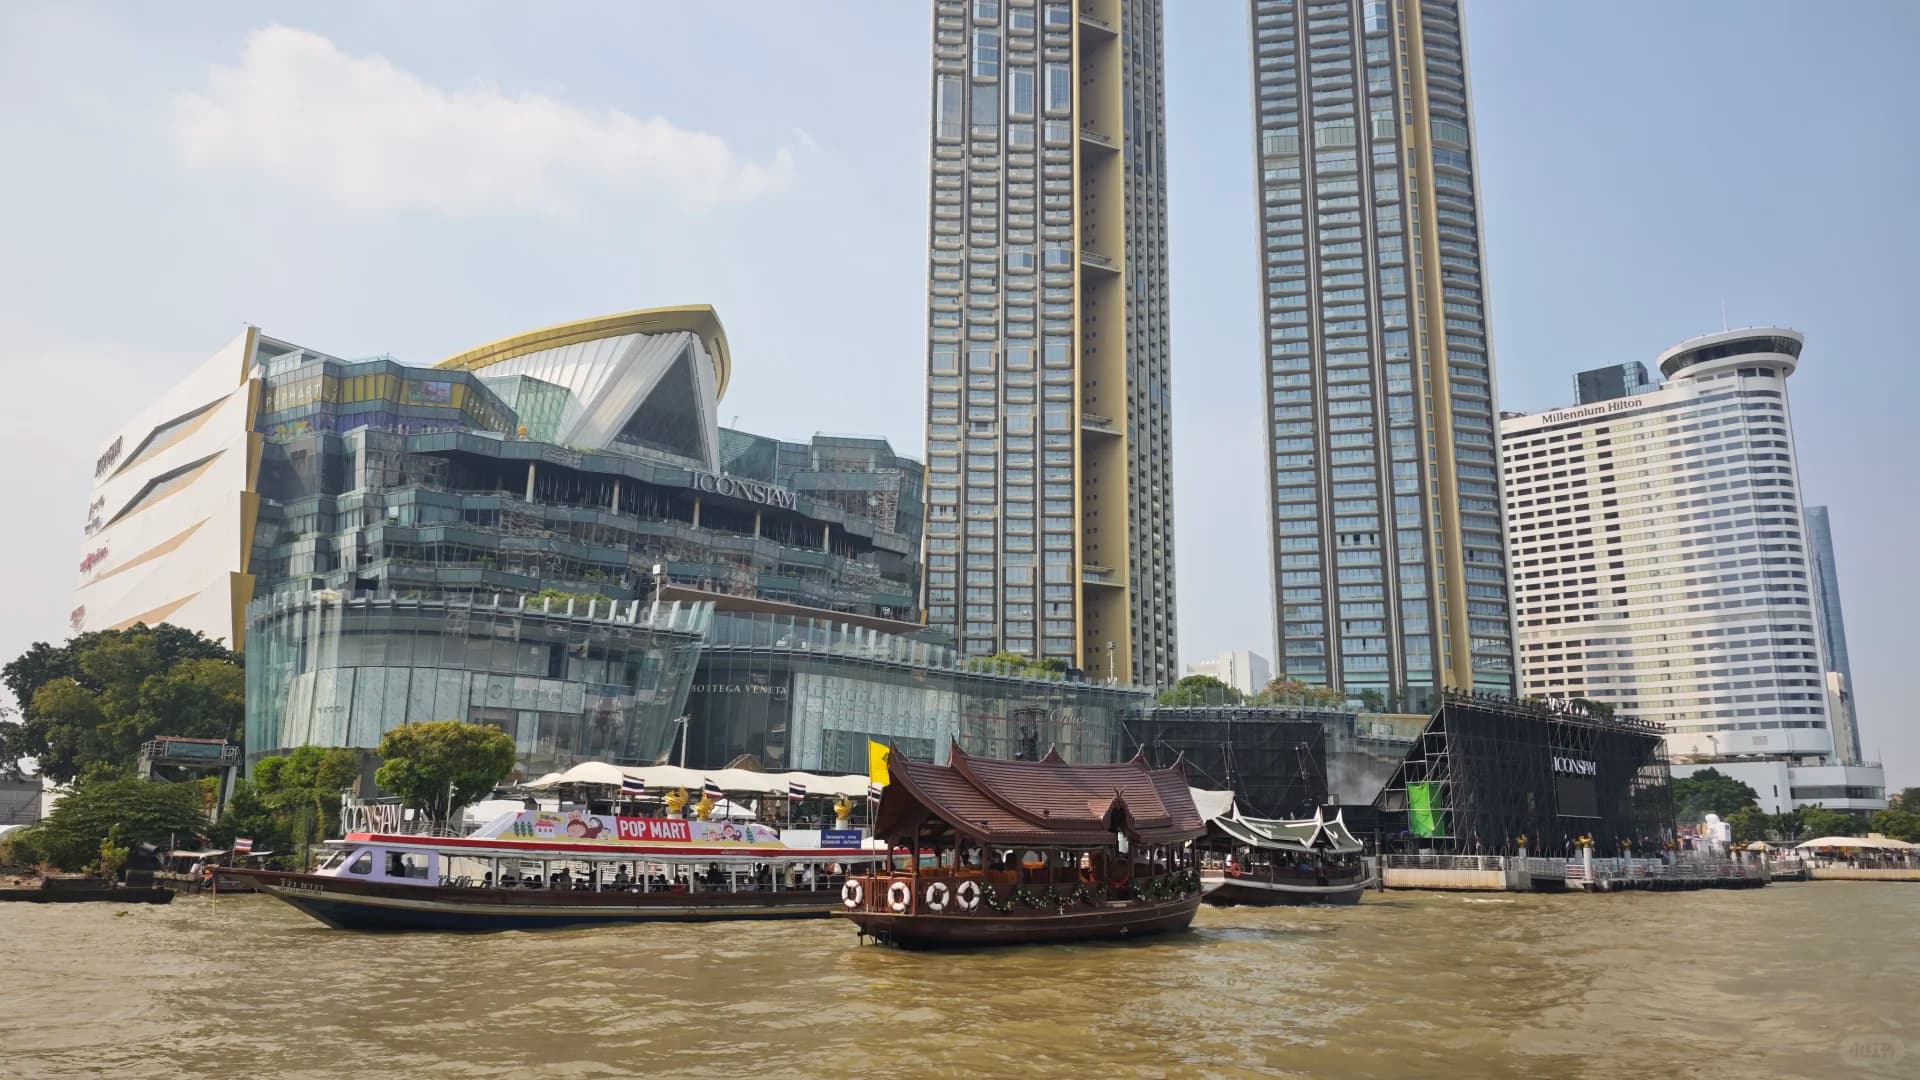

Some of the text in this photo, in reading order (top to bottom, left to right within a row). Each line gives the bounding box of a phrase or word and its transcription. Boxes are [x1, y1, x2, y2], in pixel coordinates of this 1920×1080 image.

[1542, 398, 1642, 425] Millennium Hilton
[692, 472, 799, 510] ICONSIAM
[745, 684, 788, 695] VENETA
[1553, 756, 1596, 776] ICONSIAM
[619, 820, 687, 839] POP MART
